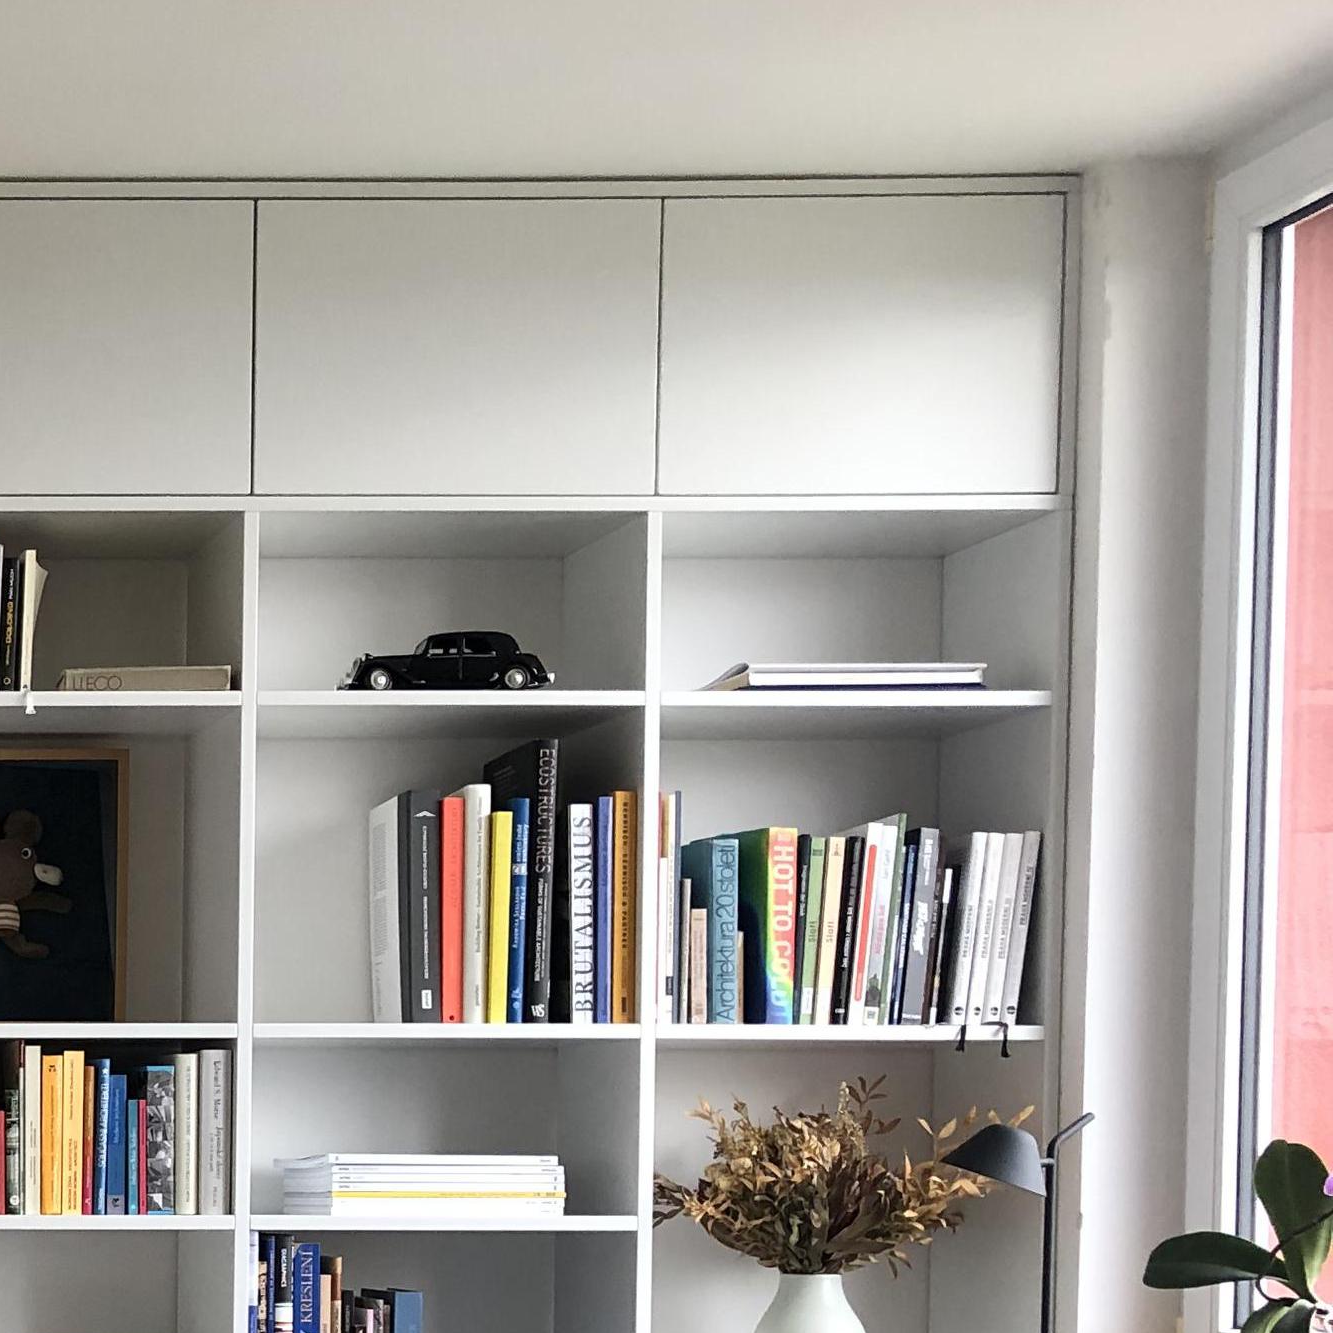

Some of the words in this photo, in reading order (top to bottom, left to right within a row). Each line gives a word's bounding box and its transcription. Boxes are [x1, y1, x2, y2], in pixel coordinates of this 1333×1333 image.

[534, 748, 556, 874] ECOSTRUCTURES
[715, 844, 736, 893] století
[772, 845, 793, 896] HOT
[572, 816, 593, 1013] BRUTALISMUS
[715, 894, 736, 918] 20
[771, 900, 793, 932] TO
[1019, 903, 1028, 925] PRAHA
[981, 937, 989, 958] PRAHA
[998, 937, 1007, 959] PRAHA
[715, 921, 736, 1022] Architektura
[213, 1060, 222, 1087] Edward
[214, 1098, 222, 1120] Morse
[297, 1250, 313, 1323] KRESLENÍ
